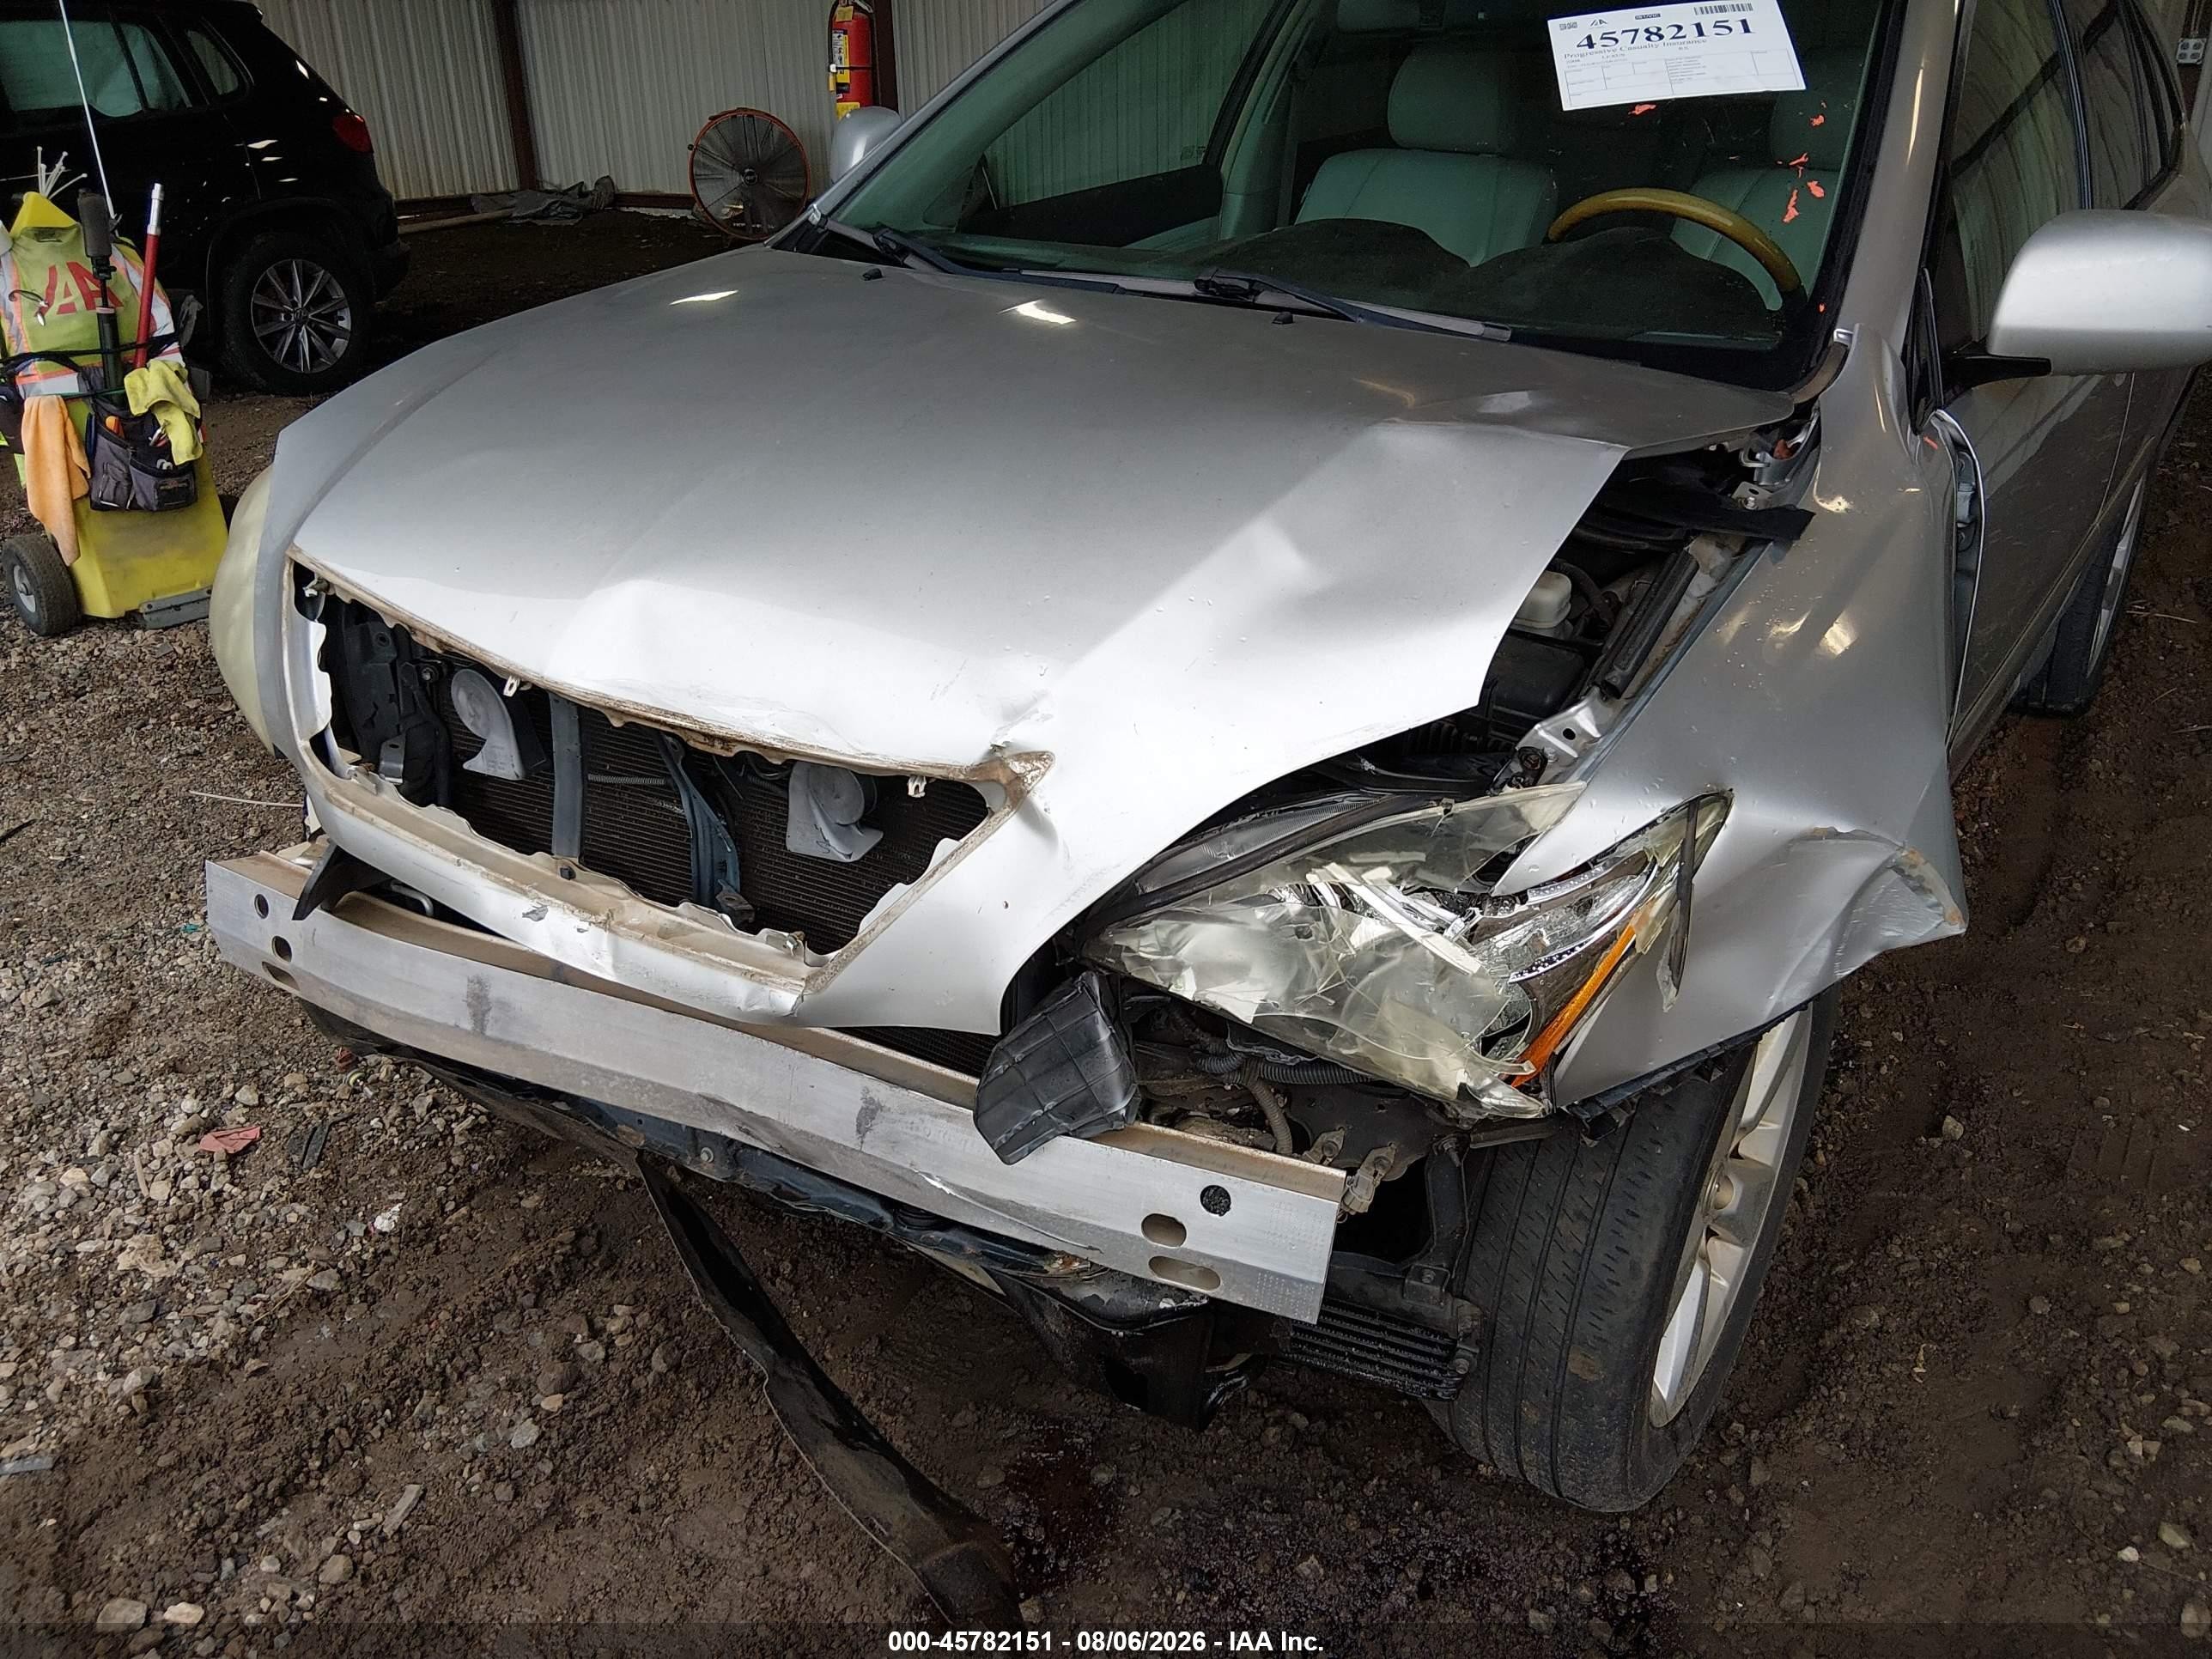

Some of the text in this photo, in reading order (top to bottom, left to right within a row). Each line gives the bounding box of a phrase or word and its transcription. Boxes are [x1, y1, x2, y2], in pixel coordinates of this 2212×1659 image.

[1576, 17, 1756, 50] 45782151
[1564, 39, 1708, 60] Progressive Casualty Insurance
